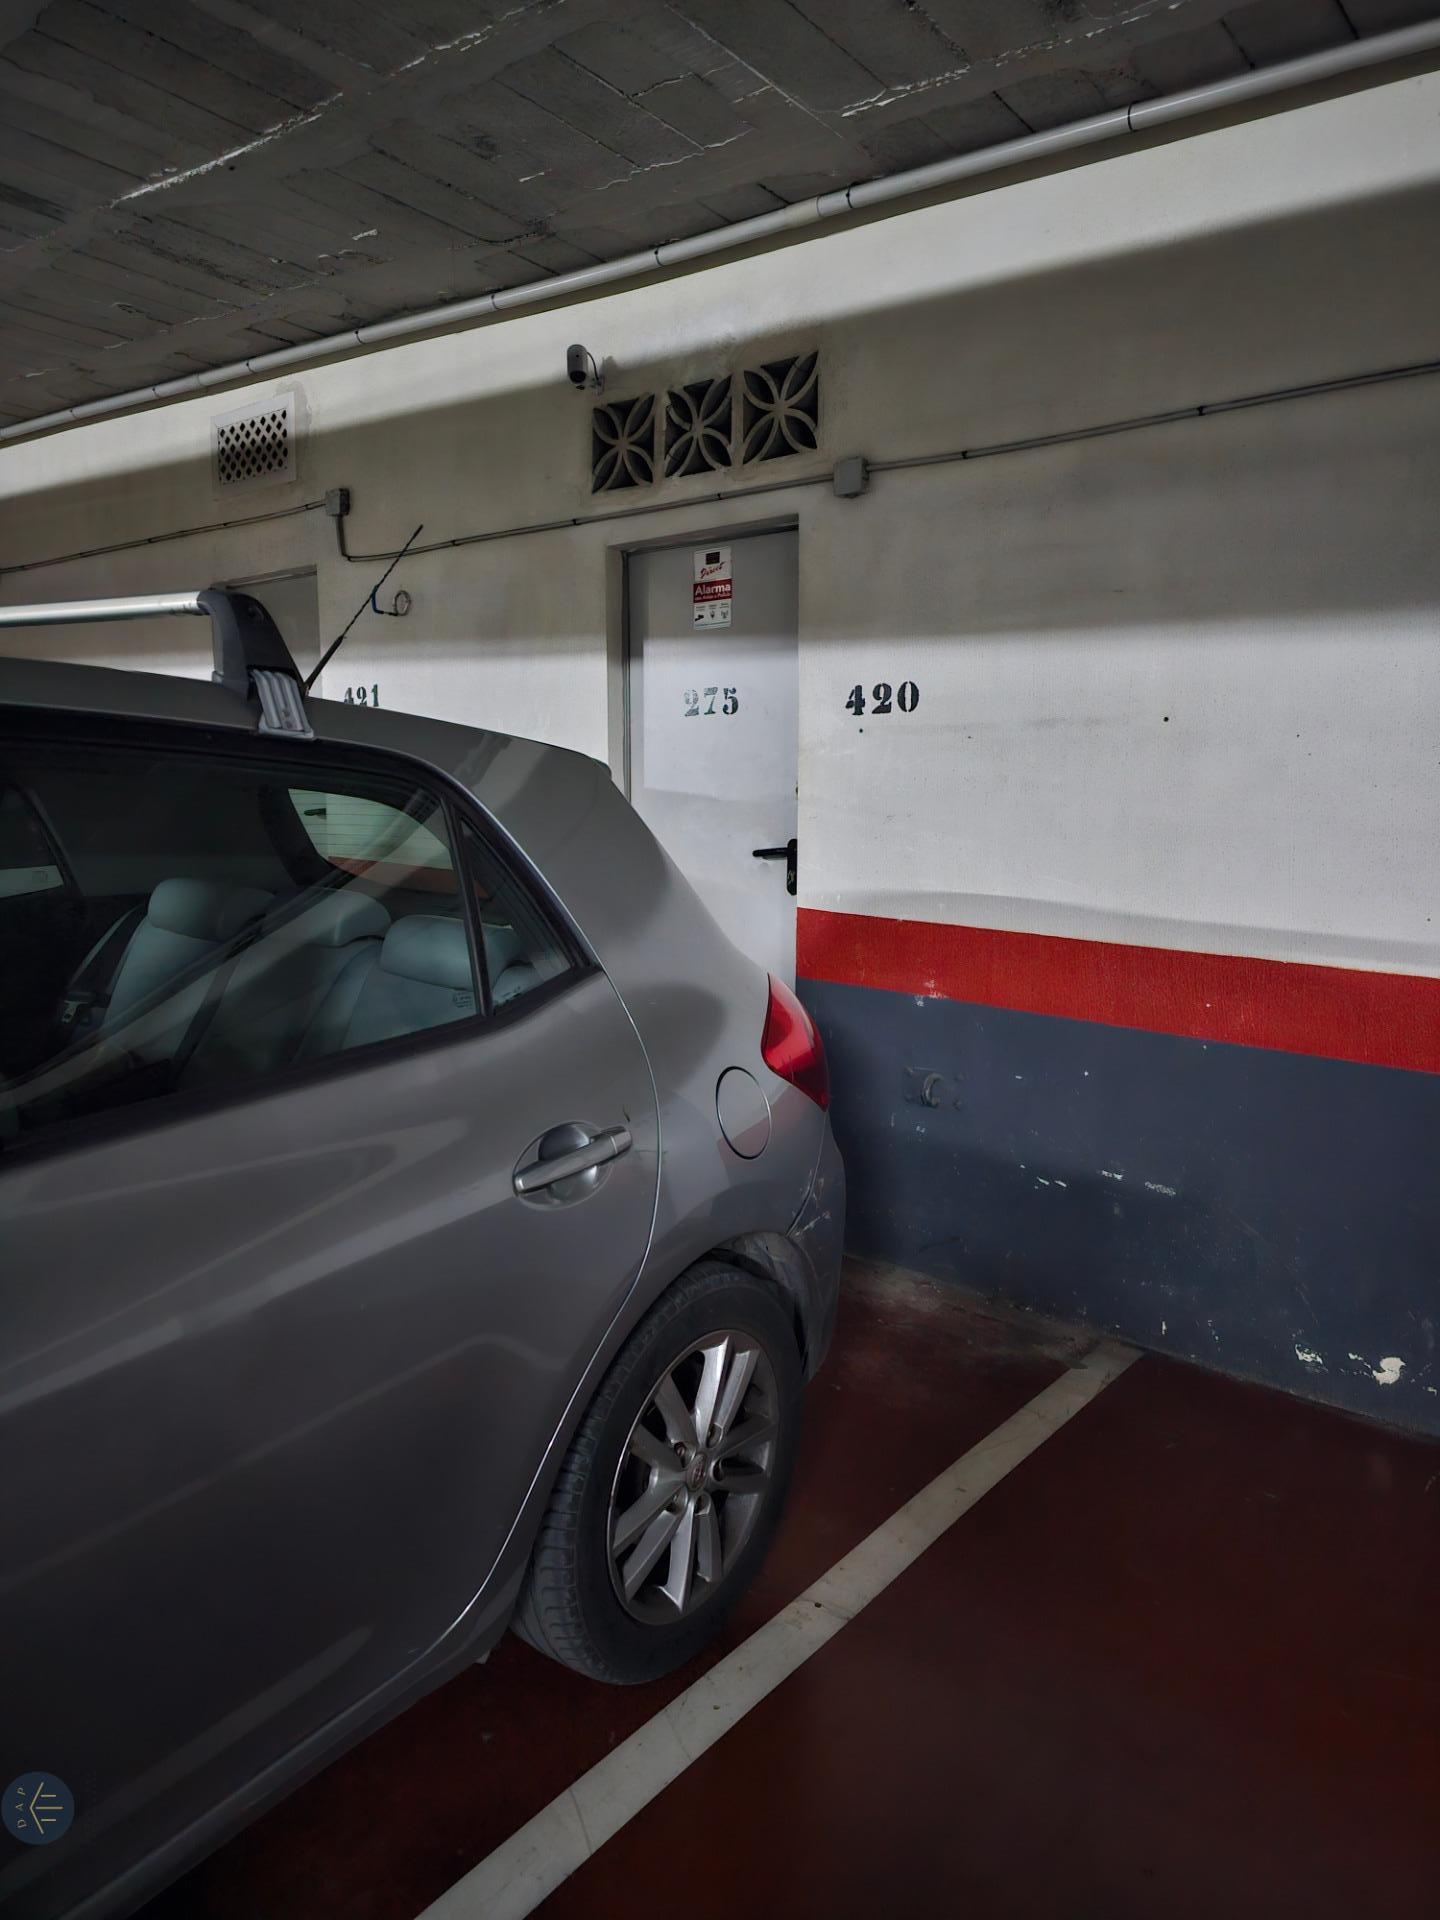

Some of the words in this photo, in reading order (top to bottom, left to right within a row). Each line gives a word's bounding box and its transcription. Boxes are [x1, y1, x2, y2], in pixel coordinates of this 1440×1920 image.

[695, 584, 732, 596] Alarma
[343, 684, 379, 707] 421
[684, 686, 739, 717] 275
[845, 681, 920, 716] 420
